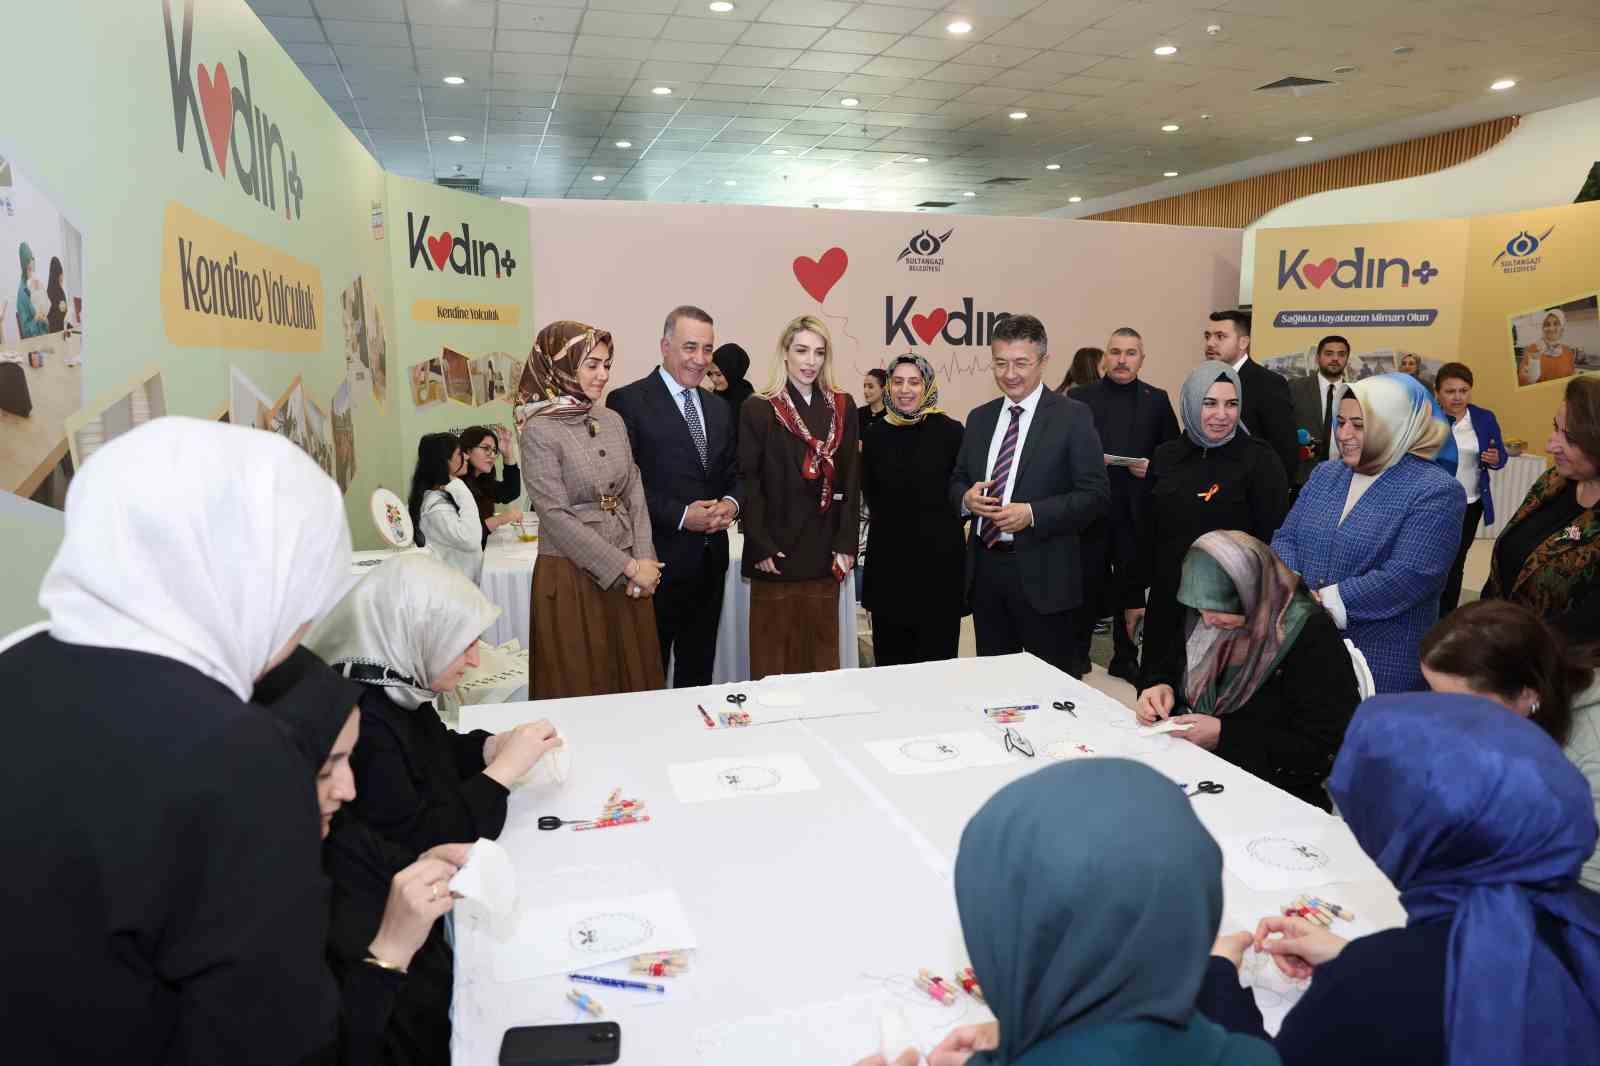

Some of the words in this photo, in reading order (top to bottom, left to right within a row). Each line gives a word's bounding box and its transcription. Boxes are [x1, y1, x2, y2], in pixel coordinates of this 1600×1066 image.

[178, 236, 264, 323] Kendine
[263, 267, 317, 330] Yolculuk
[437, 305, 469, 320] Kendine
[1406, 312, 1429, 322] Olun
